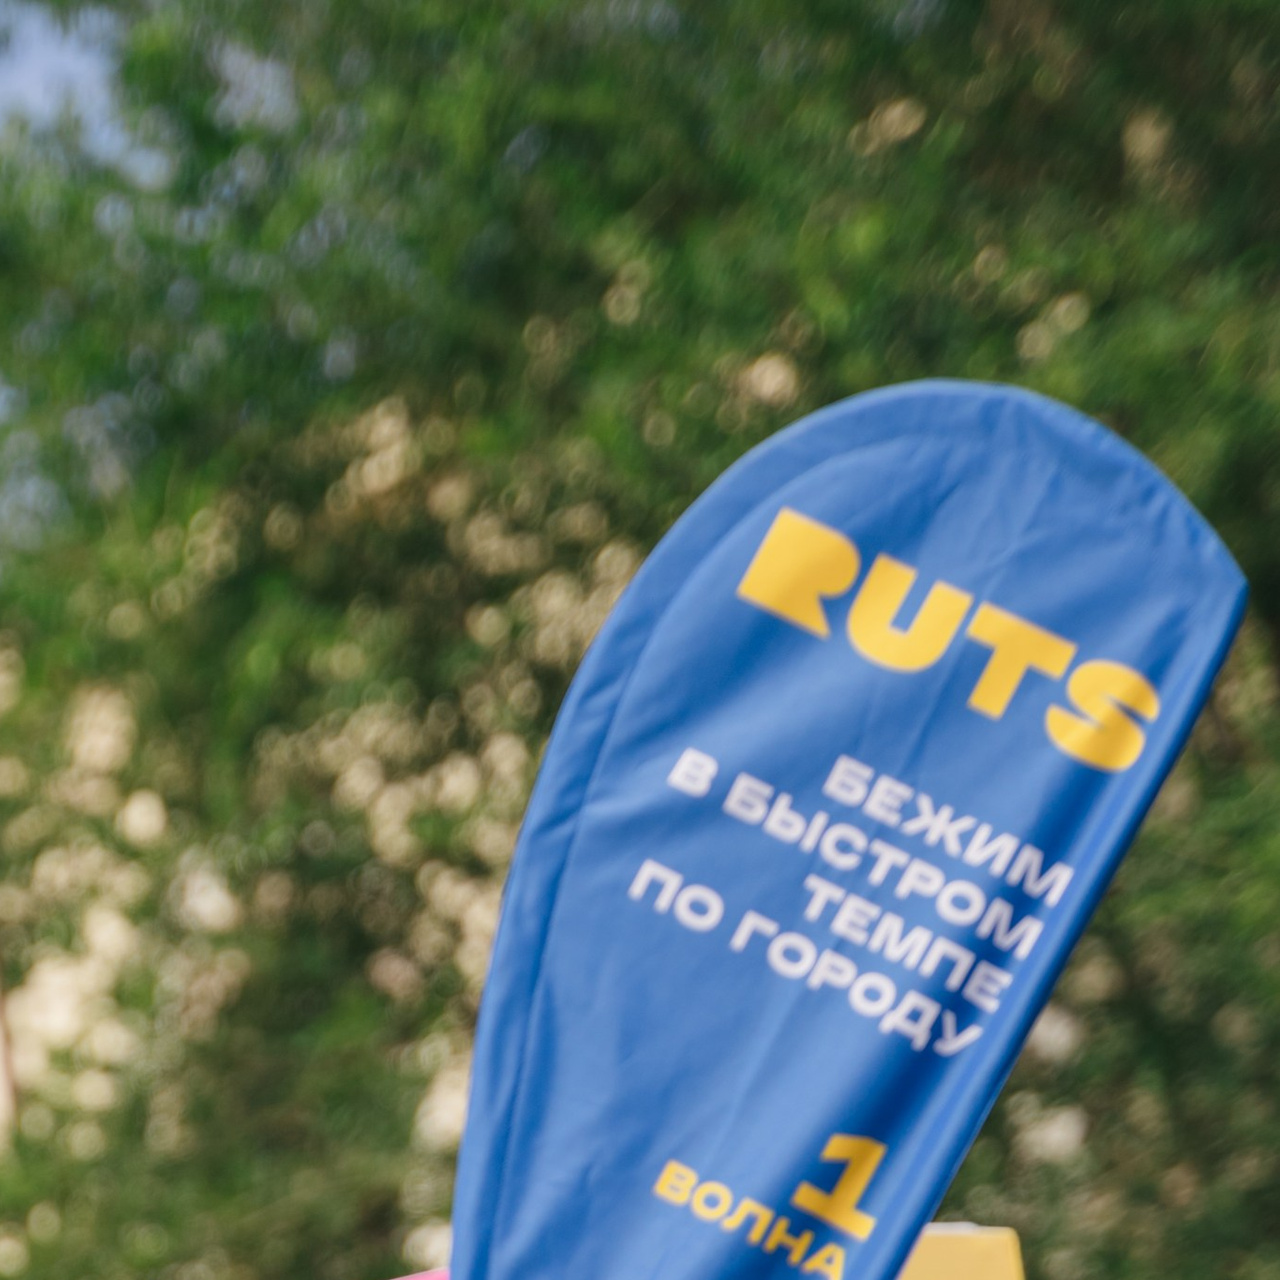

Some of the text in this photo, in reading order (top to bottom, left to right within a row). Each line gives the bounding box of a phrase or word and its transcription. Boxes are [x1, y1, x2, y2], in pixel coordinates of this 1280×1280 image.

[738, 508, 1160, 772] RUTS
[667, 747, 1044, 961] В БЫСТРОМ
[823, 754, 1074, 908] БЕЖИМ
[628, 859, 984, 1057] ПО ГОРОДУ
[804, 874, 1013, 1014] ТЕМПЕ
[790, 1133, 888, 1242] 1
